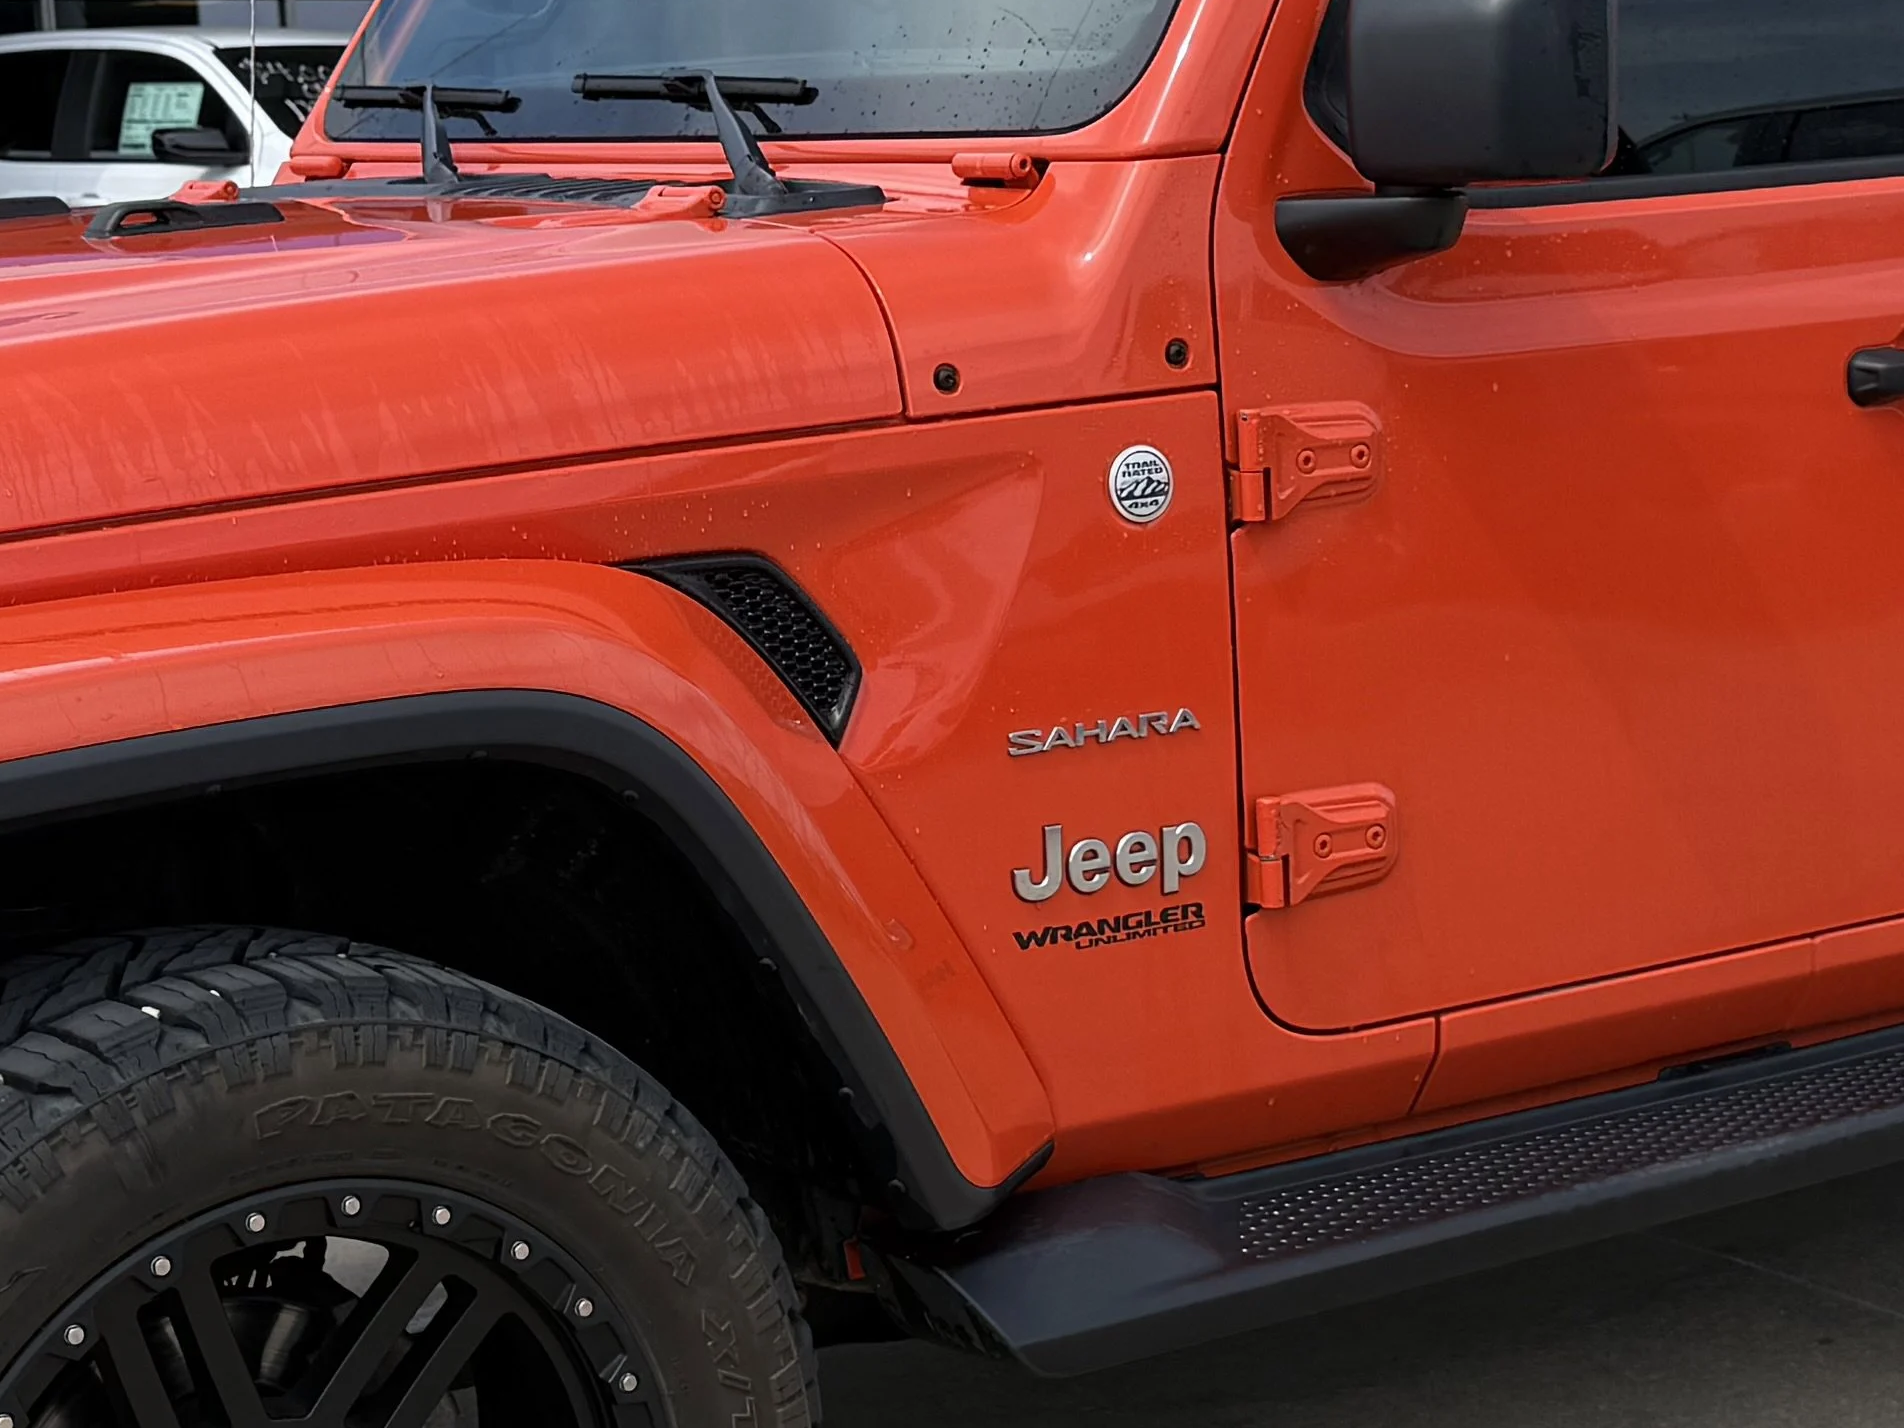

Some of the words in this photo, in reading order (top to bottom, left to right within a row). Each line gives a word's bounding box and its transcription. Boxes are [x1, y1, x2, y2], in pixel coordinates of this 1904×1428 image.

[1008, 708, 1201, 756] SAHARA
[1012, 821, 1207, 903] Jeep
[1012, 902, 1204, 951] WRANGLER
[1075, 920, 1205, 950] UNLIMITED
[254, 1089, 698, 1287] PATAGONIA
